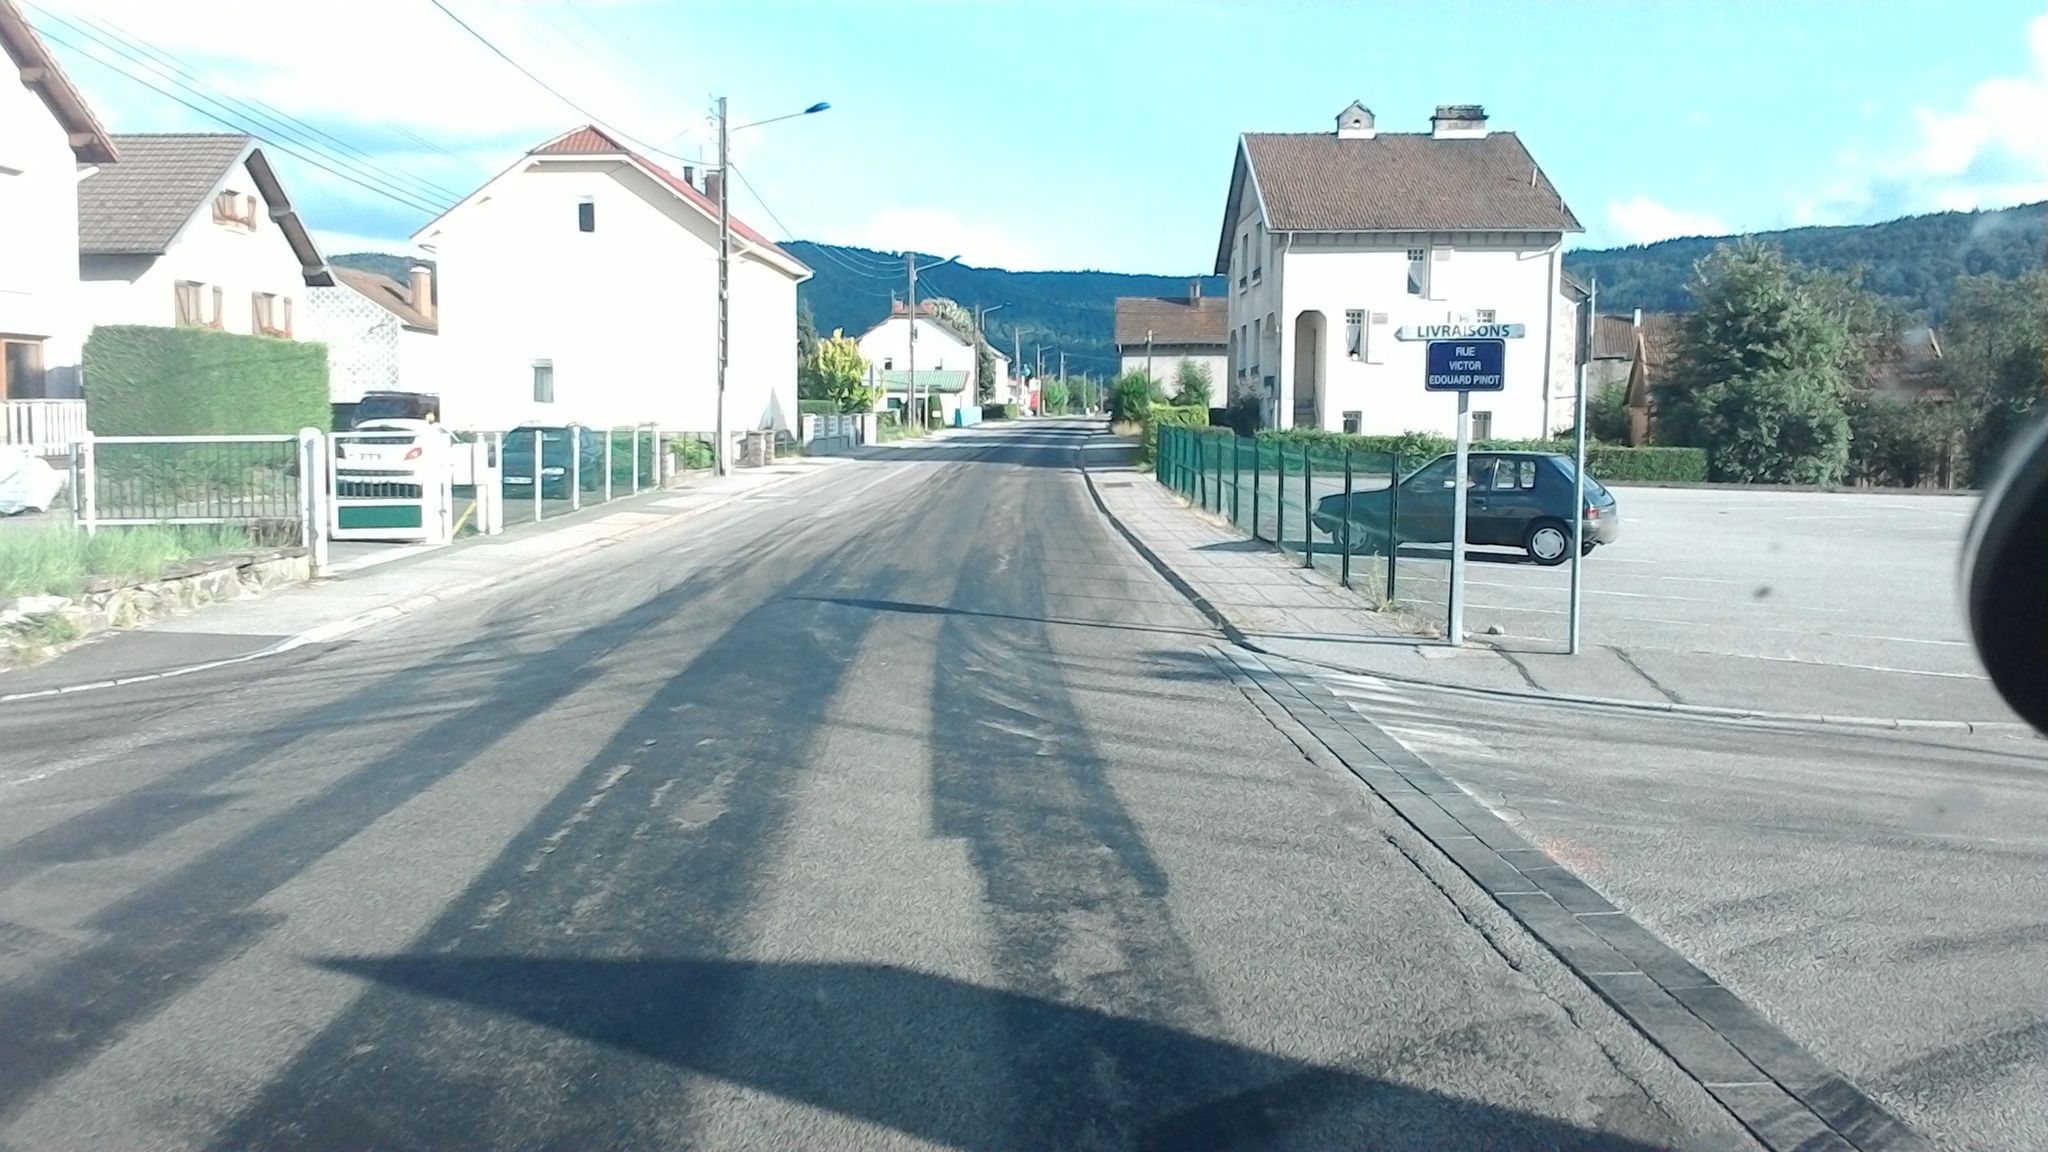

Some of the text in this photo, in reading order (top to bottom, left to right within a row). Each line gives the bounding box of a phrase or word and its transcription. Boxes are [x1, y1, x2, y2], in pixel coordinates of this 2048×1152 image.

[1417, 325, 1510, 338] LIVRAISONS
[1455, 346, 1476, 357] RUE
[1449, 361, 1482, 371] VICTOR
[1429, 374, 1500, 385] EDOUARD PINOT
